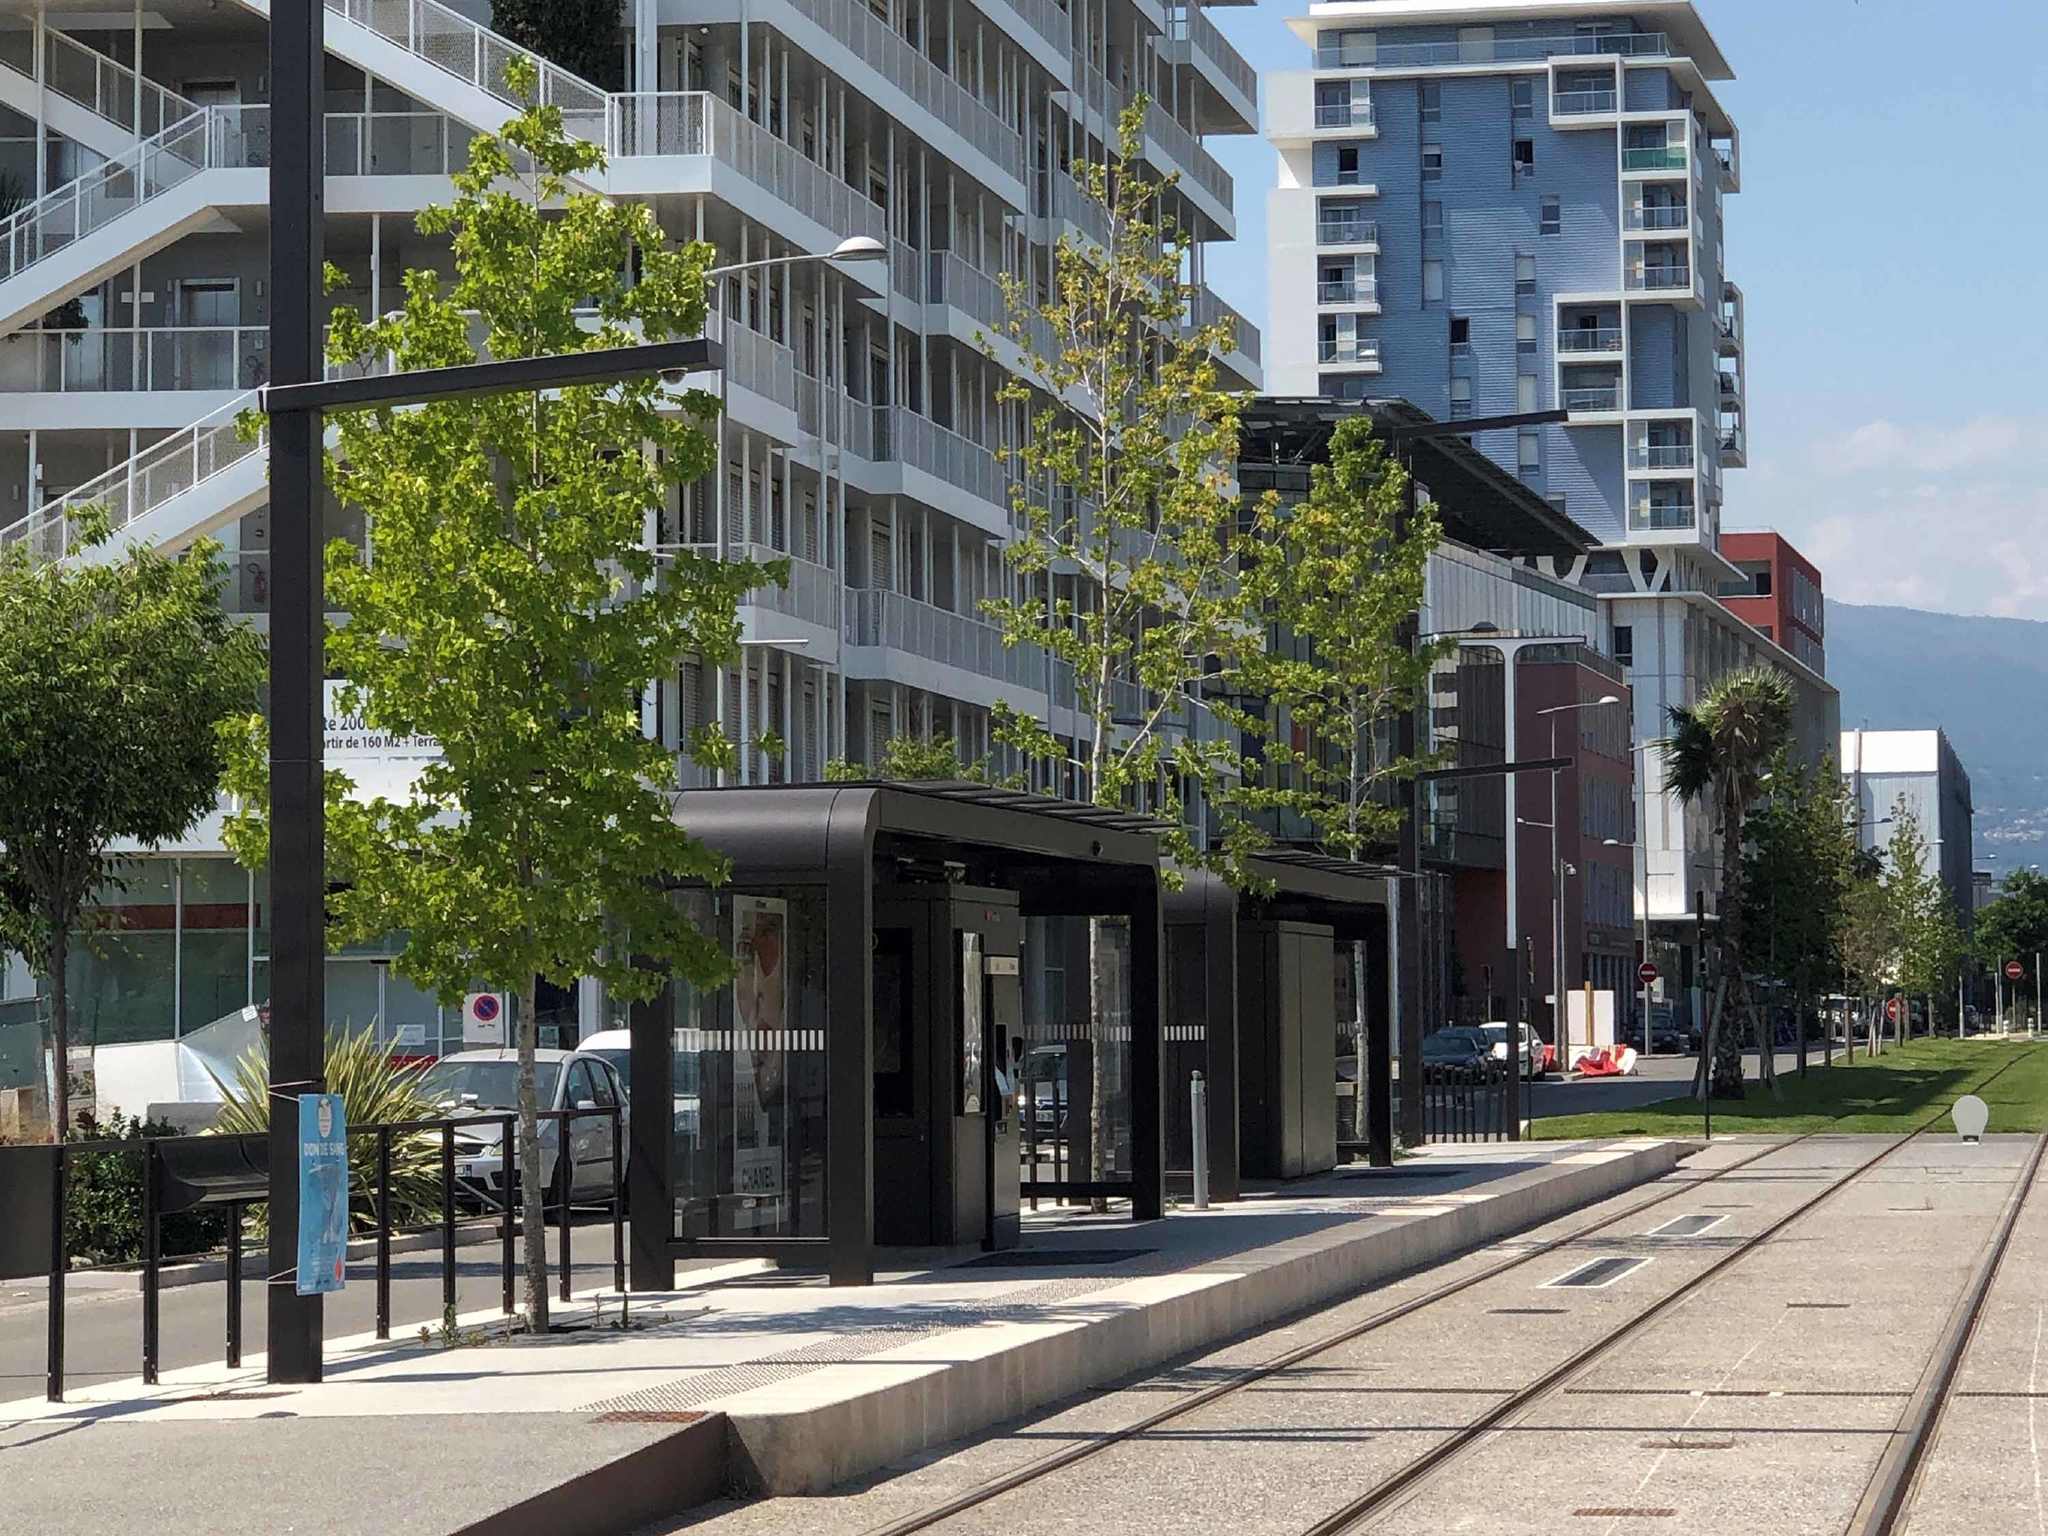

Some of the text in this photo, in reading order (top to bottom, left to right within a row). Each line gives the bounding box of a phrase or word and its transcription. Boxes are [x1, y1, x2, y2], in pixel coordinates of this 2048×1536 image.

[346, 736, 359, 748] de
[361, 736, 382, 748] 160
[384, 735, 401, 748] M2
[742, 1166, 777, 1190] CHANEL
